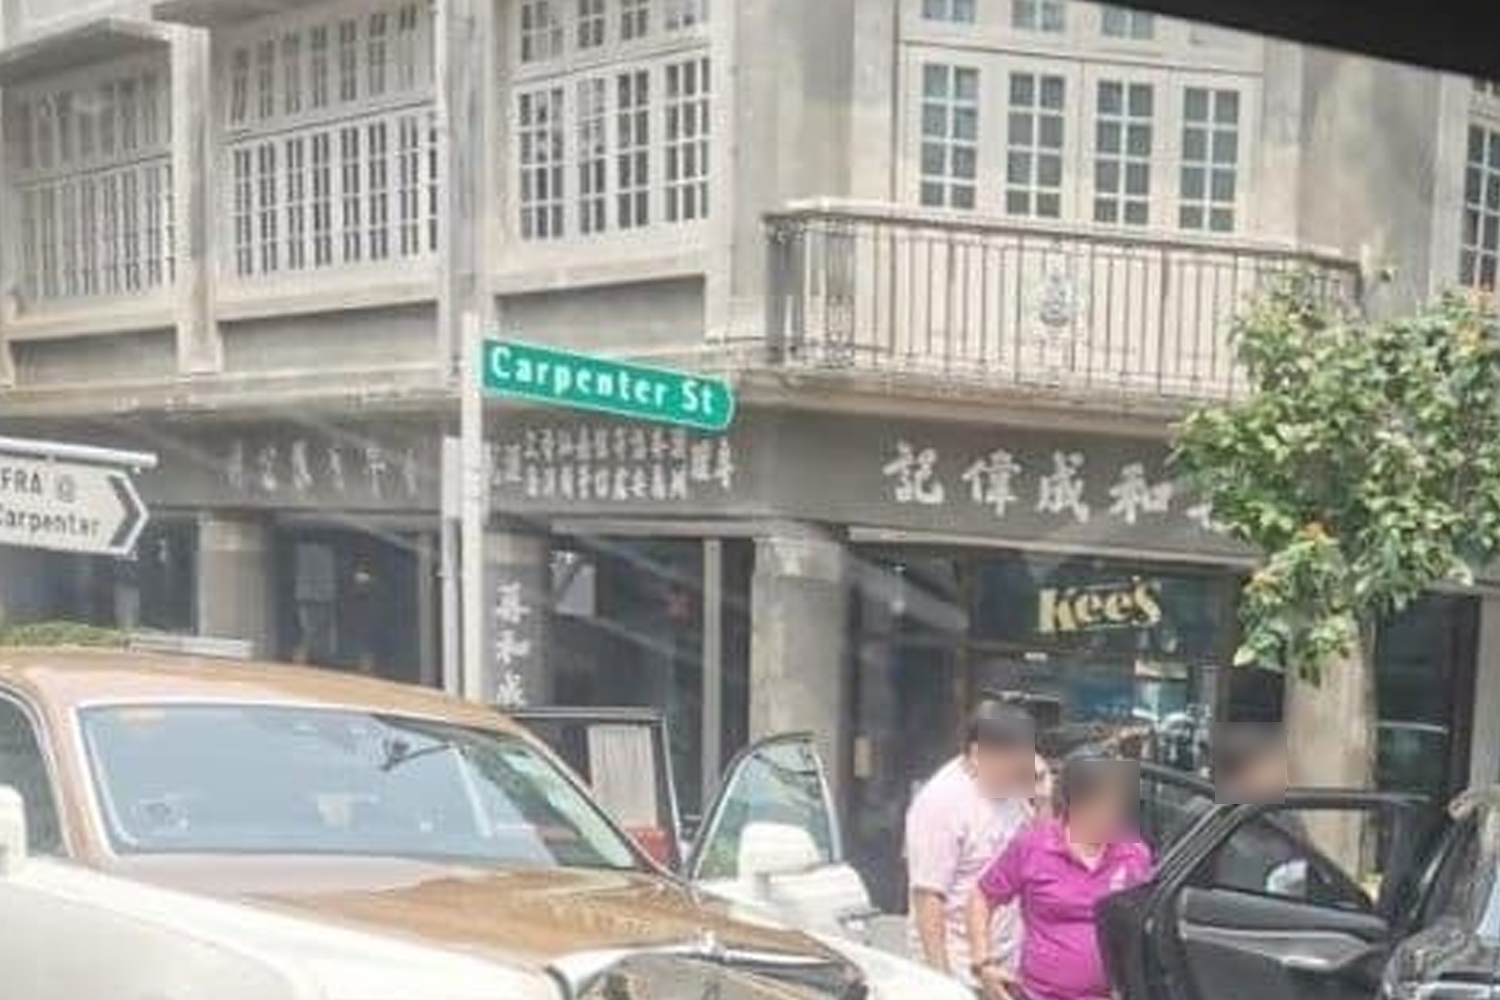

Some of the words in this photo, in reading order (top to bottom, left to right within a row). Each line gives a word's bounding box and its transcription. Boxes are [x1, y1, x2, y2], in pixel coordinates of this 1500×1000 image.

[491, 346, 668, 407] Carpenter
[682, 379, 712, 415] St
[0, 503, 100, 537] arpenter
